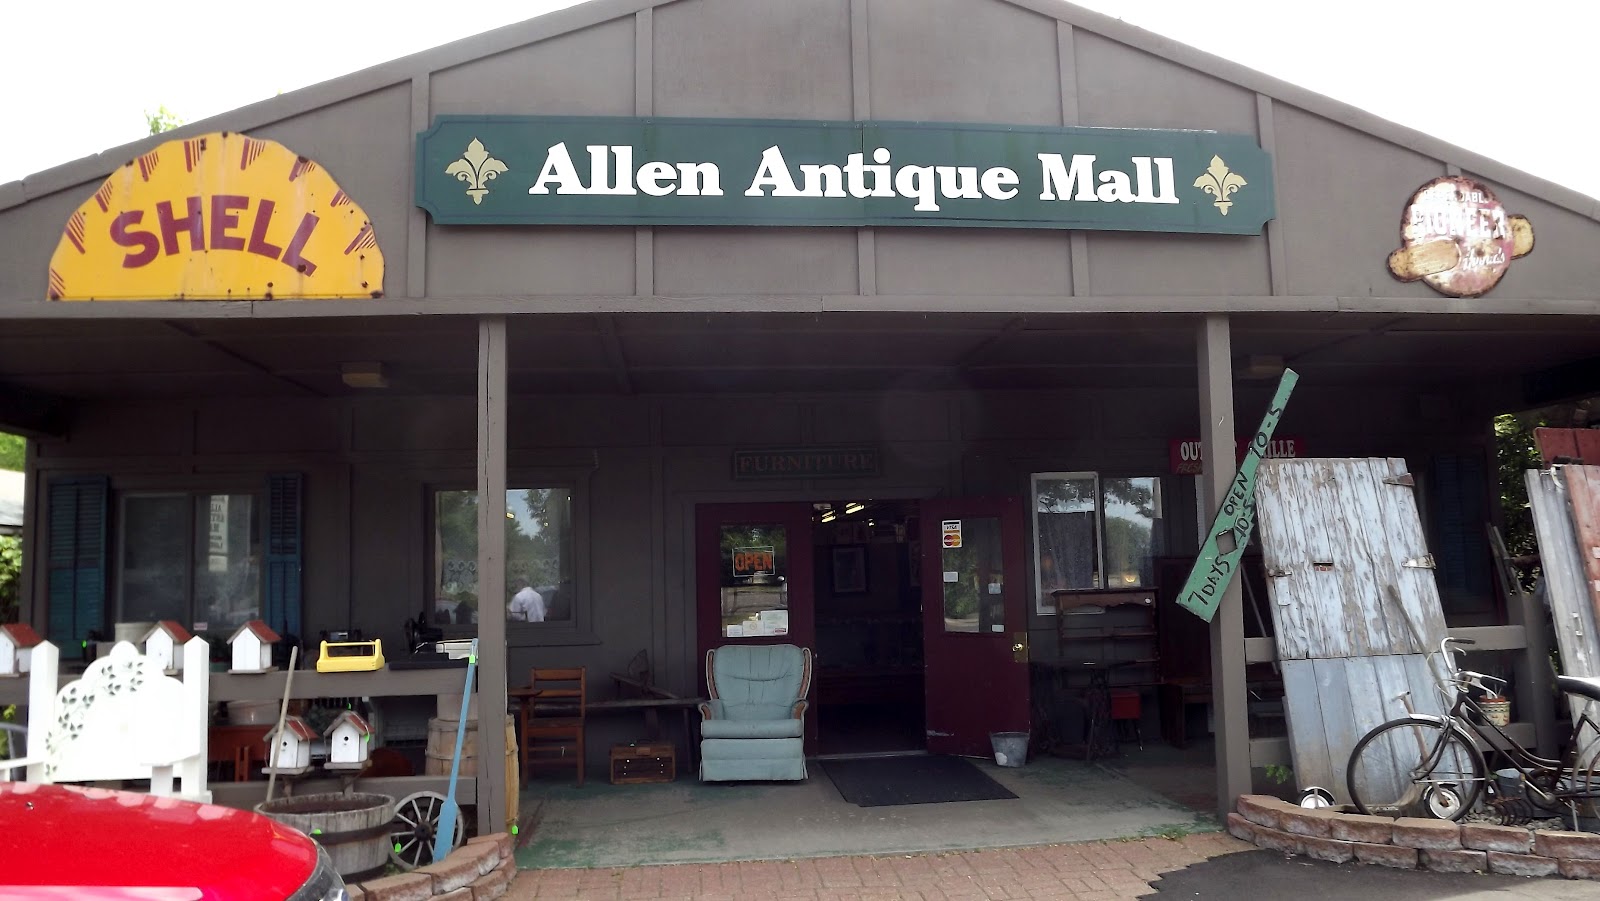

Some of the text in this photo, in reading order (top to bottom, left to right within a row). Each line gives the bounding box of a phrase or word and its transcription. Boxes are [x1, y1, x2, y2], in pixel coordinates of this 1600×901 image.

[528, 141, 1180, 212] Allen Antique Mall
[109, 194, 320, 278] SHELL
[740, 453, 873, 473] FURNITURE
[1223, 470, 1249, 517] OPEN
[734, 551, 773, 572] OPEN
[1187, 554, 1231, 606] 7 DAYS
